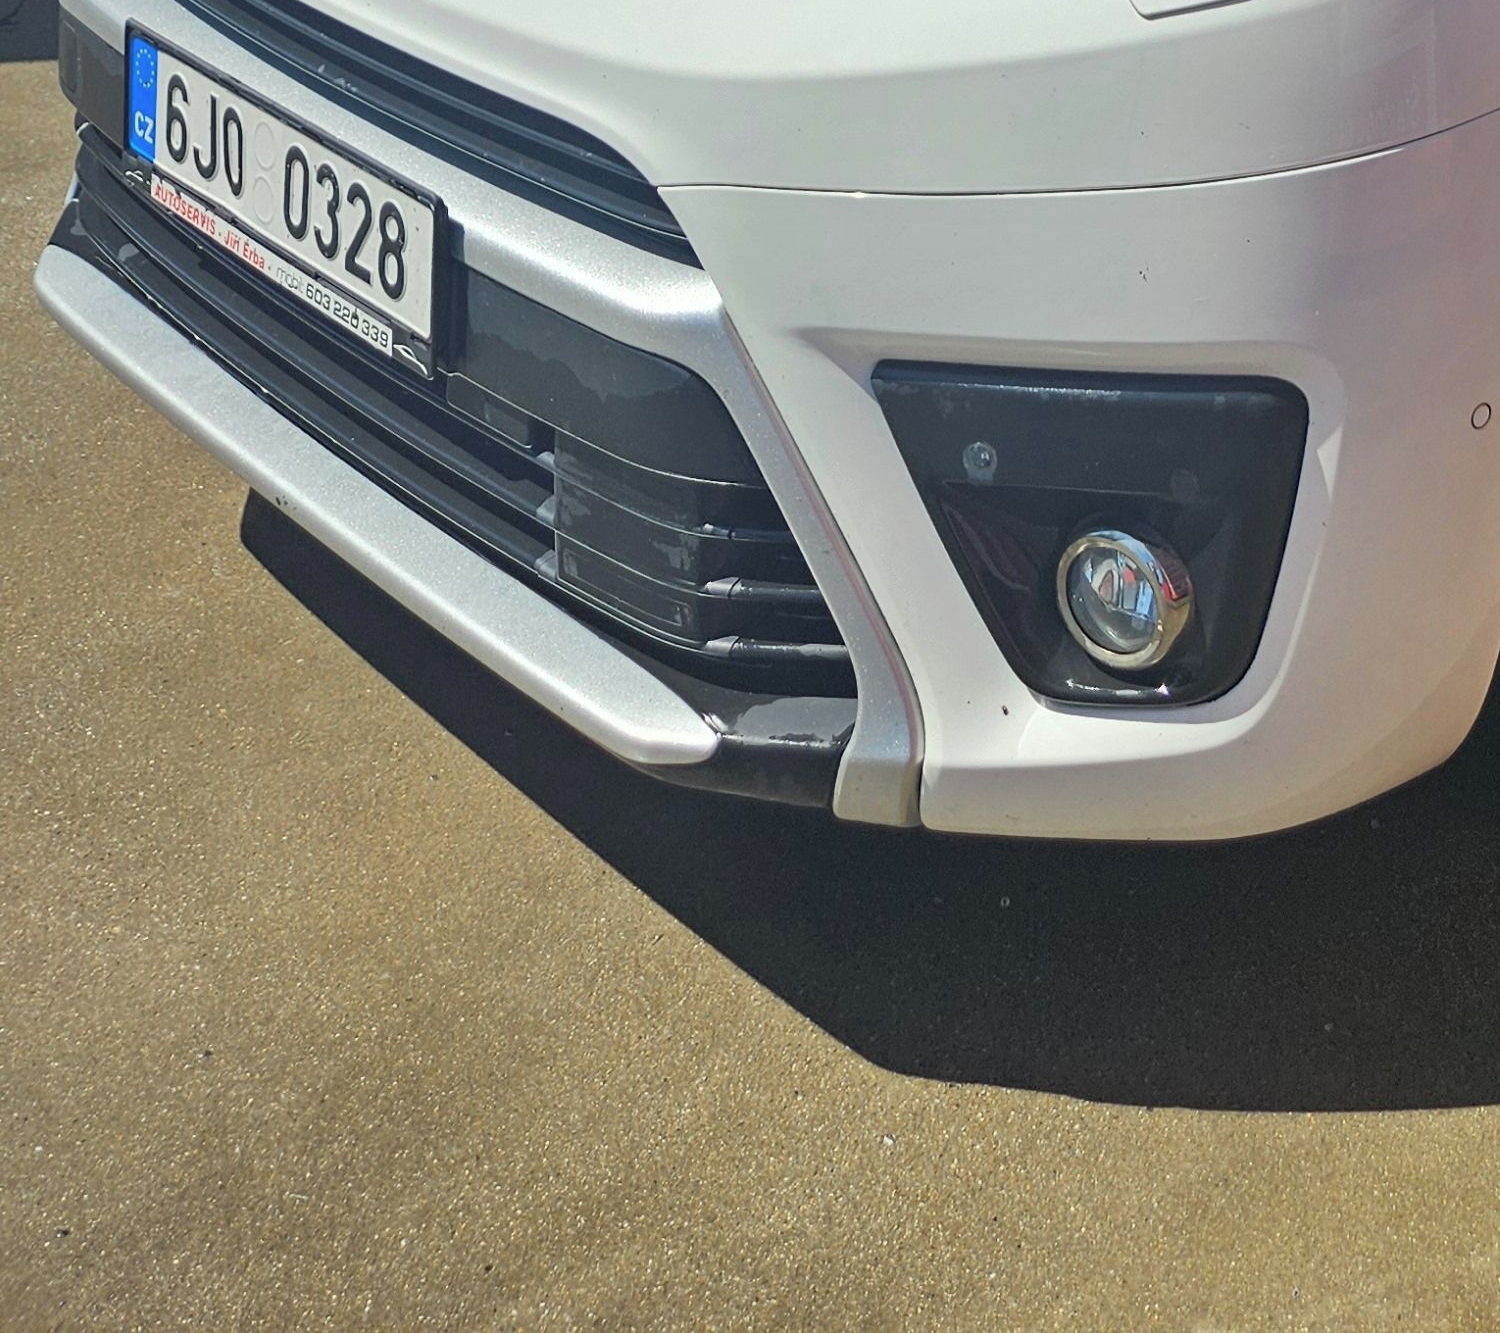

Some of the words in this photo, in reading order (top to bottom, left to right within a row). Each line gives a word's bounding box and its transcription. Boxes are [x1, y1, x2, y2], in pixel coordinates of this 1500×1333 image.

[134, 109, 154, 144] CZ
[165, 73, 244, 197] 6J0
[283, 145, 407, 301] 0328
[154, 184, 216, 235] AUTOSERVIS
[305, 282, 331, 311] 603
[361, 319, 389, 348] 339
